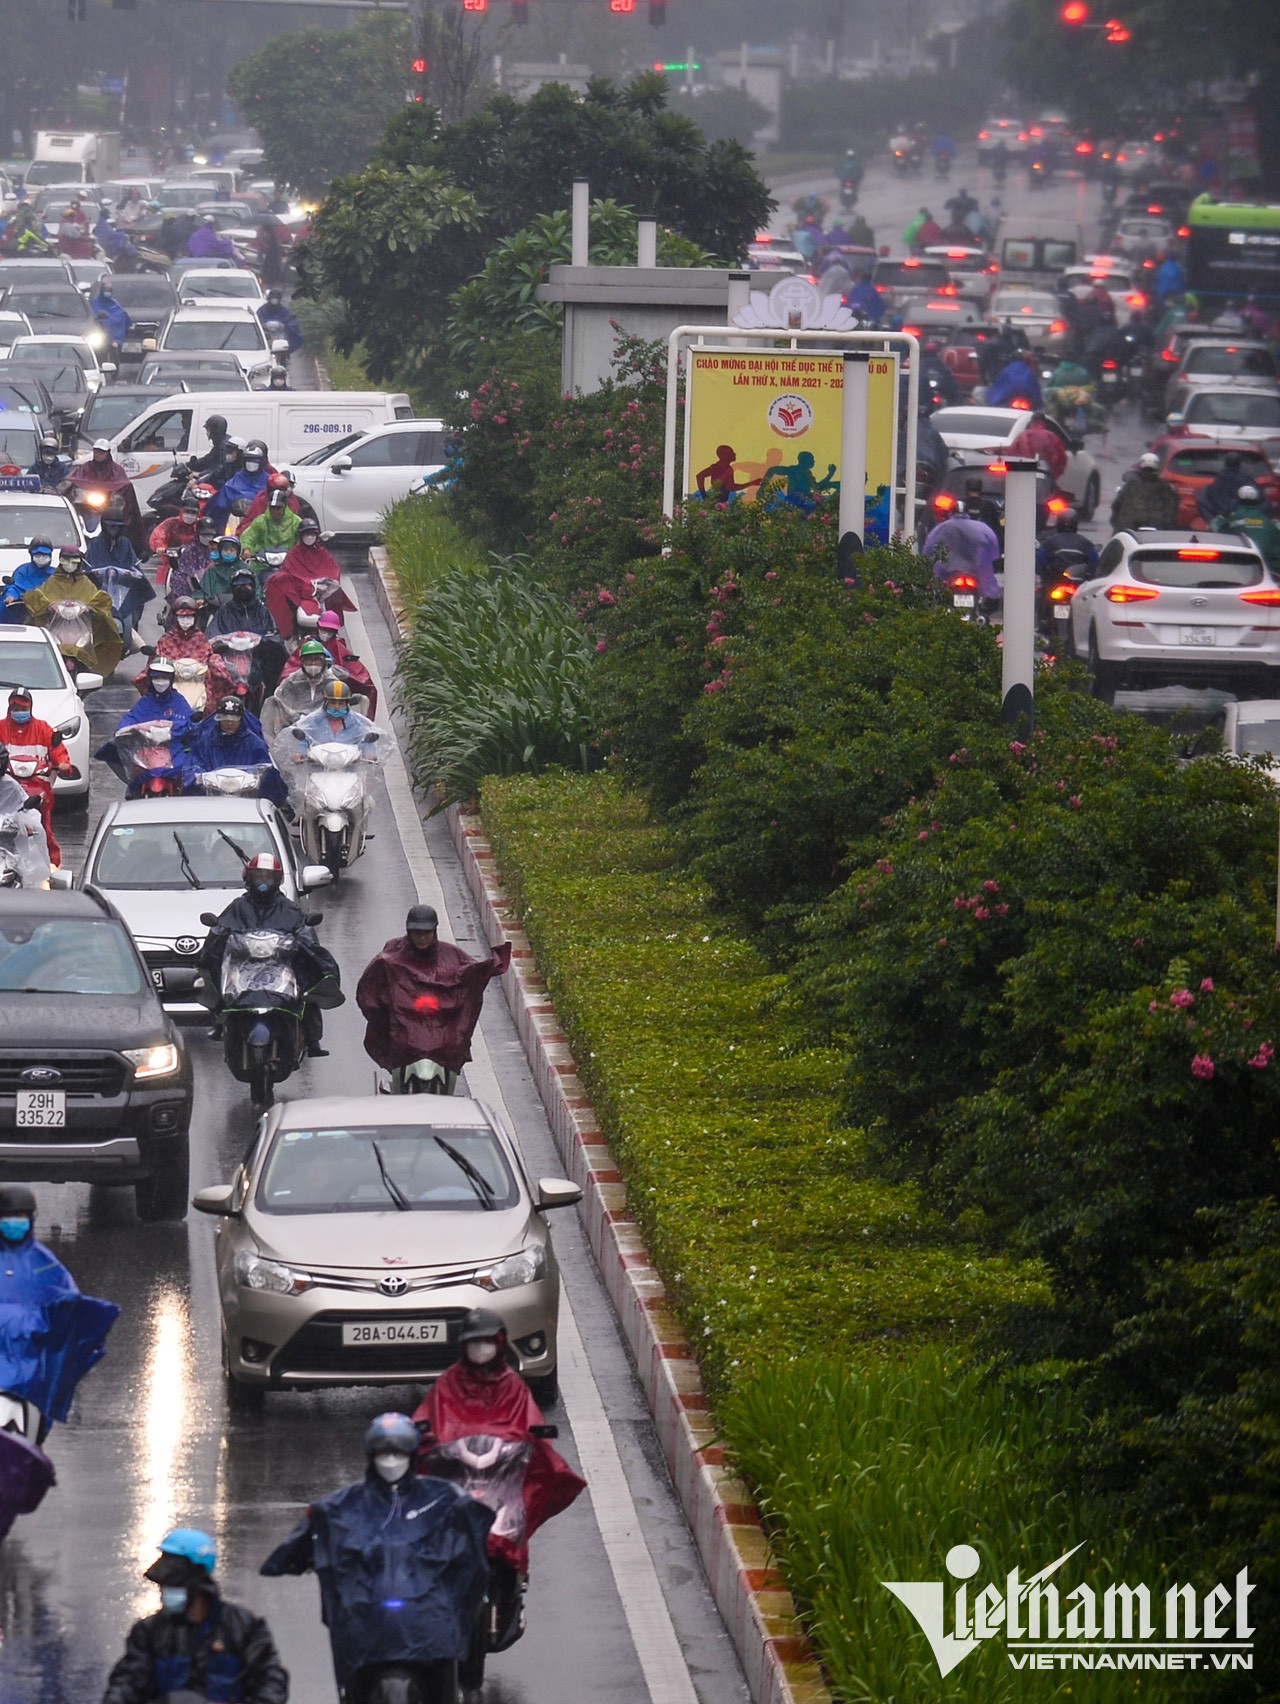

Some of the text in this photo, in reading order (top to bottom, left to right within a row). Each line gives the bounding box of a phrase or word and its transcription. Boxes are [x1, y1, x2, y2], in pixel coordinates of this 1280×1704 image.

[696, 357, 719, 370] CHÀO
[721, 358, 746, 370] MỪNG
[748, 360, 762, 372] ĐẠI
[765, 359, 779, 373] HỘI
[781, 358, 796, 371] THỂ
[798, 361, 816, 374] DỤC
[818, 359, 833, 373] THỂ
[876, 362, 888, 374] ĐÔ
[752, 374, 768, 386] THỨ
[780, 375, 800, 387] NĂM
[802, 378, 821, 388] 2021
[830, 379, 844, 388] 202
[303, 423, 353, 433] 29G-009.18
[28, 1093, 55, 1109] 29H
[18, 1110, 64, 1126] 335.22
[352, 1325, 439, 1341] 28A-044.67
